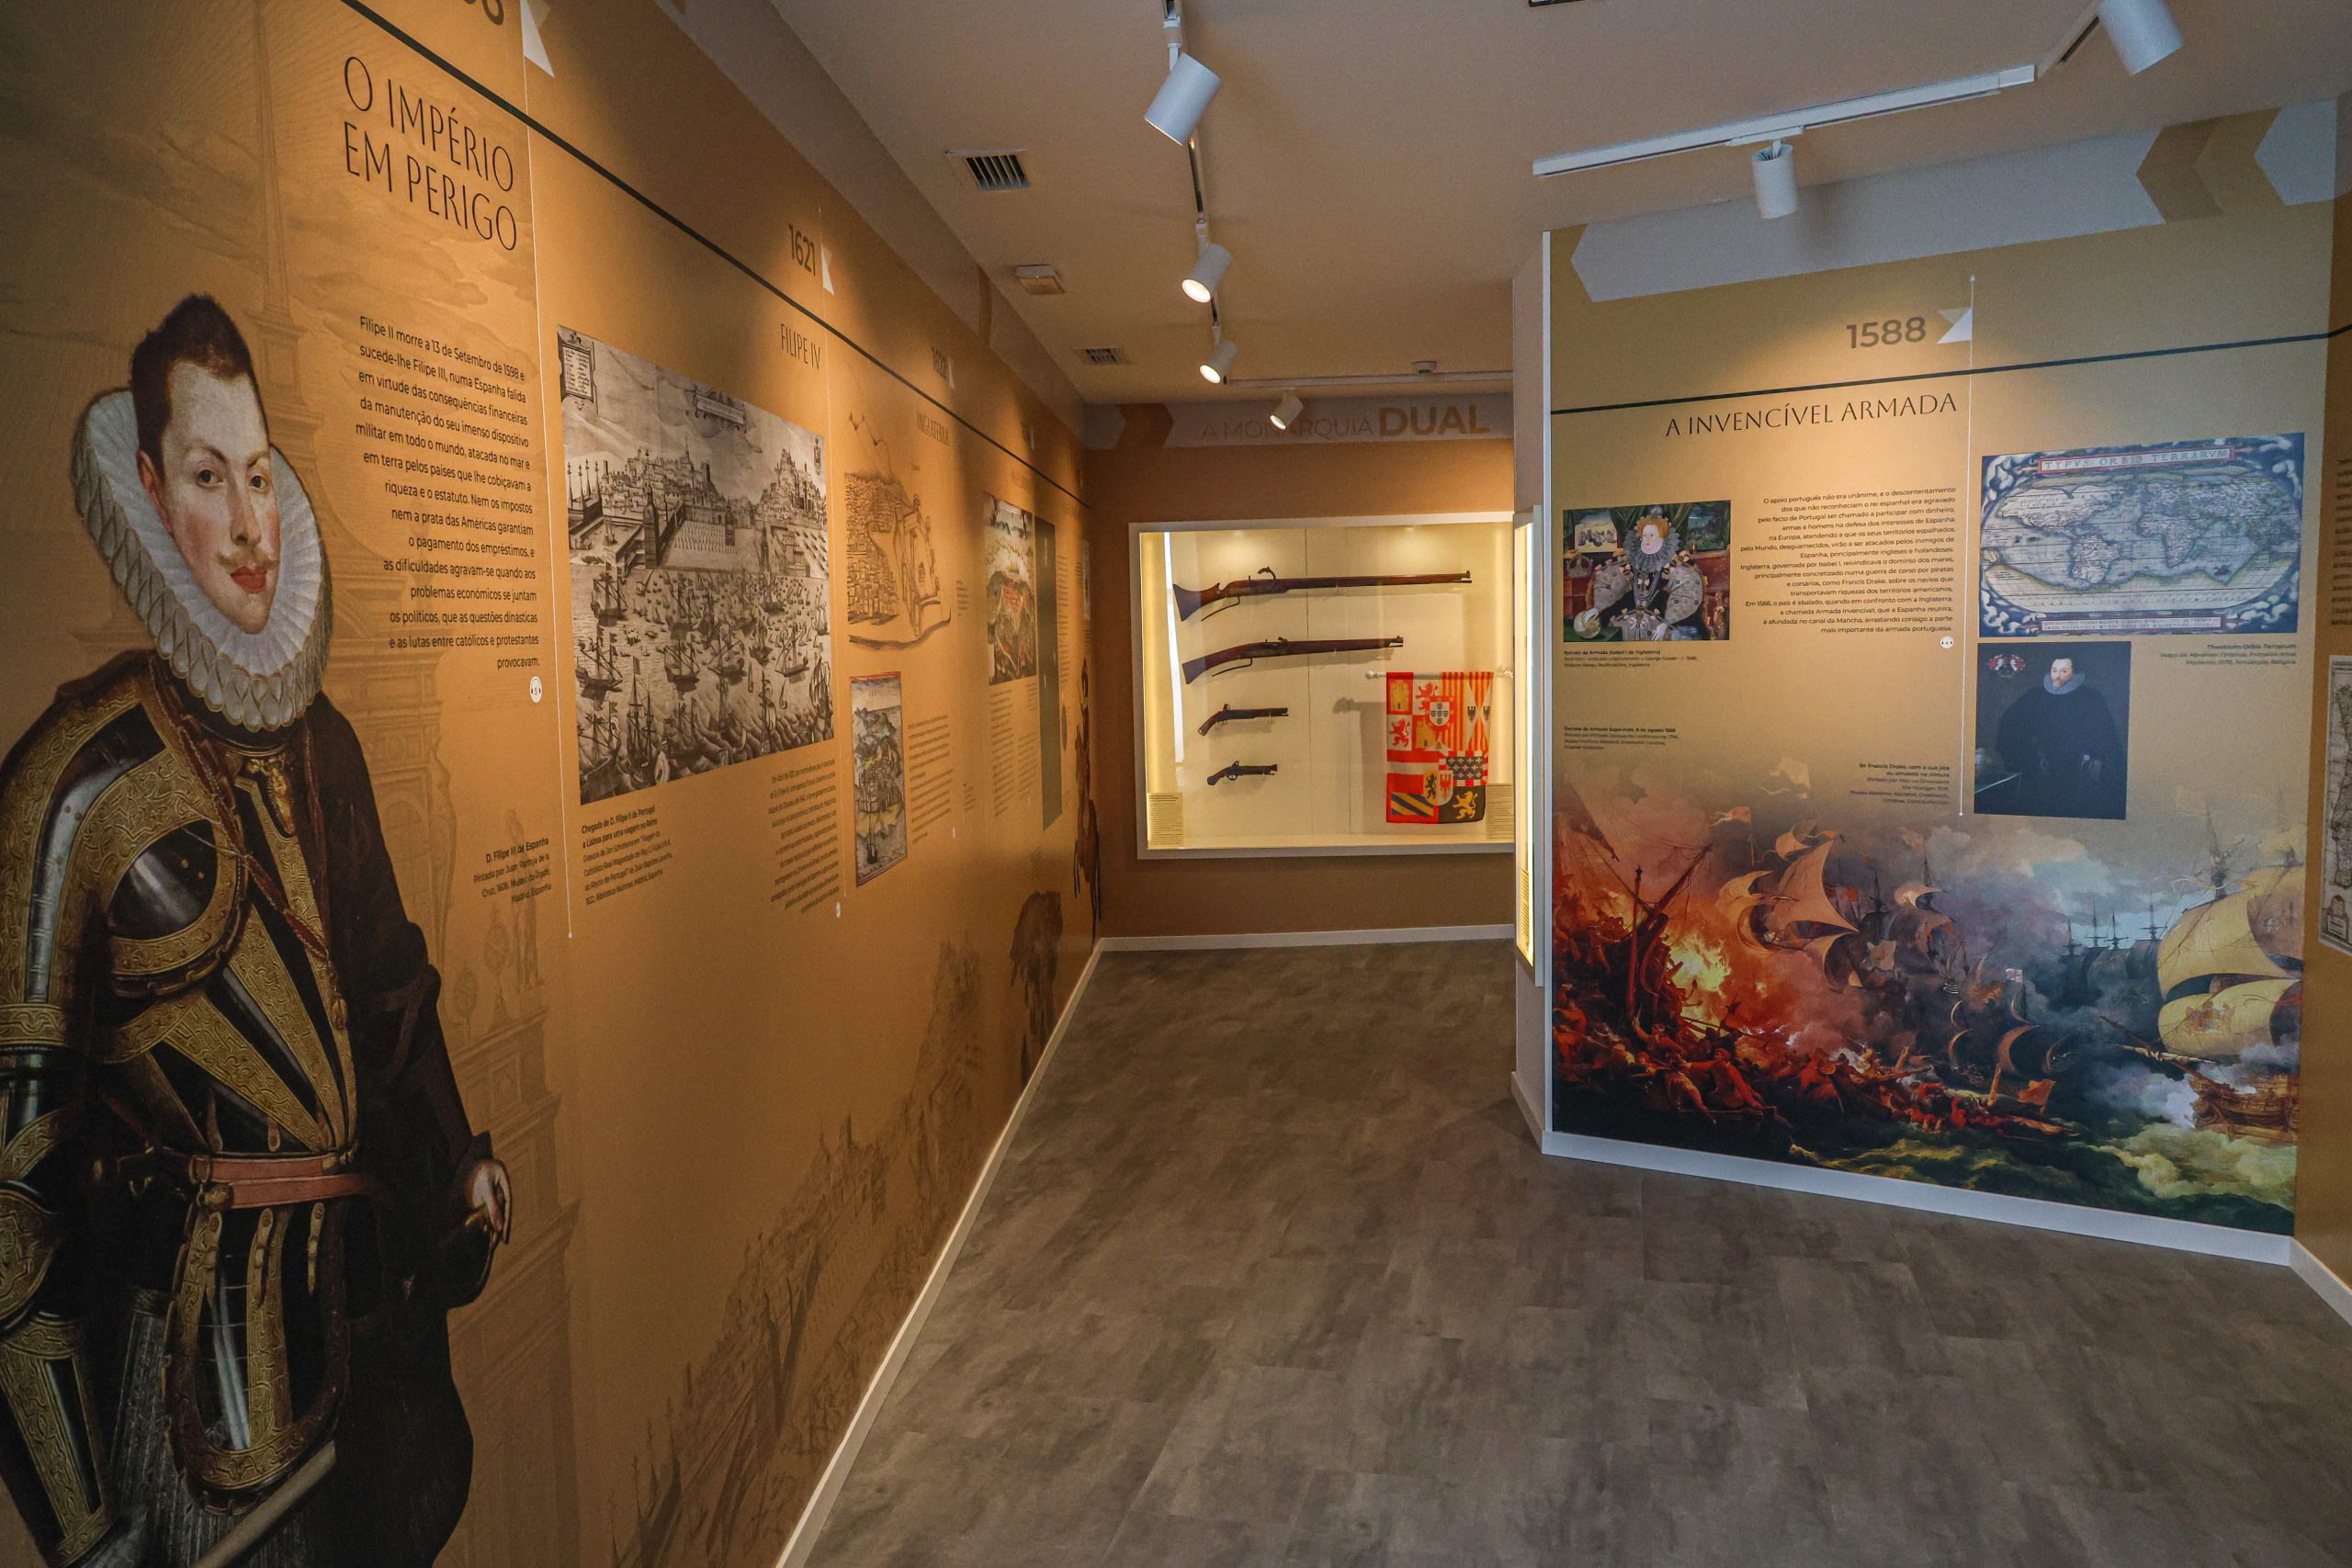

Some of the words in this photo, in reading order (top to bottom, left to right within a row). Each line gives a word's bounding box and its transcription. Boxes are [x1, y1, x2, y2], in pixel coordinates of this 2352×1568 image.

[345, 56, 373, 112] O
[388, 78, 514, 192] IMPÉRIO
[344, 121, 392, 192] EM
[407, 154, 516, 251] PERIGO
[788, 222, 815, 276] 1621
[359, 315, 386, 336] Filipe
[388, 324, 393, 338] II
[396, 331, 423, 348] morre
[424, 340, 430, 351] a
[431, 339, 440, 354] 13
[441, 344, 452, 357] de
[454, 347, 492, 370] Setembro
[492, 360, 503, 374] de
[503, 363, 518, 378] 1598
[520, 372, 525, 380] e
[781, 323, 808, 364] FILIPE
[811, 342, 820, 369] IV
[1846, 316, 1927, 349] 1588
[359, 345, 411, 369] sucede-lhe
[413, 358, 435, 377] Filipe
[437, 366, 447, 382] III,
[449, 372, 472, 388] numa
[474, 377, 505, 397] Espanha
[506, 387, 526, 403] falida
[358, 371, 374, 385] em
[376, 377, 409, 394] virtude
[411, 384, 427, 399] das
[428, 390, 487, 415] consequências
[488, 403, 527, 425] financeiras
[1666, 419, 1680, 436] A
[1689, 403, 1834, 434] INVENCÍVEL
[1841, 393, 1957, 422] ARMADA
[360, 396, 372, 411] da
[374, 401, 432, 425] manutenção
[433, 413, 444, 428] do
[446, 419, 459, 432] seu
[461, 420, 490, 438] imenso
[491, 428, 528, 447] dispositivo
[1202, 423, 1216, 440] A
[1380, 404, 1490, 436] DUAL
[356, 423, 386, 440] militar
[389, 431, 403, 443] em
[405, 434, 426, 448] todo
[427, 439, 434, 450] o
[435, 441, 467, 458] mundo,
[468, 447, 498, 463] atacada
[499, 455, 509, 465] no
[510, 457, 524, 468] mar
[526, 460, 529, 469] e
[363, 452, 379, 464] em
[380, 454, 402, 468] terra
[405, 458, 428, 473] pelos
[457, 469, 472, 482] que
[473, 470, 486, 483] lhe
[487, 474, 526, 491] cobiçavam
[526, 482, 531, 491] a
[385, 479, 418, 496] riqueza
[419, 488, 424, 498] e
[426, 489, 433, 499] o
[434, 490, 469, 503] estatuto.
[470, 493, 489, 507] Nem
[491, 499, 499, 509] os
[500, 501, 532, 513] impostos
[391, 509, 412, 521] nem
[413, 512, 419, 522] a
[421, 513, 443, 525] prata
[445, 513, 459, 526] das
[461, 515, 496, 531] Américas
[497, 523, 533, 535] garantiam
[408, 536, 414, 547] o
[416, 536, 464, 551] pagamento
[465, 539, 480, 552] dos
[529, 548, 534, 558] e
[383, 559, 393, 570] as
[395, 558, 448, 574] dificuldades
[449, 564, 494, 577] agravam-se
[495, 567, 523, 579] quando
[524, 570, 536, 579] aos
[410, 584, 455, 600] problemas
[456, 587, 502, 600] económicos
[503, 591, 511, 600] se
[511, 588, 537, 603] juntam
[390, 612, 401, 623] os
[402, 609, 440, 625] políticos,
[441, 613, 458, 625] que
[458, 613, 468, 623] as
[469, 611, 503, 625] questões
[389, 638, 395, 649] e
[397, 637, 408, 649] as
[409, 634, 430, 648] lutas
[432, 636, 454, 647] entre
[455, 634, 489, 647] católicos
[490, 636, 494, 645] e
[496, 635, 538, 648] protestantes
[497, 657, 539, 670] provocavam.
[493, 849, 509, 861] Filipe
[517, 844, 525, 853] de
[526, 837, 548, 852] Espanha
